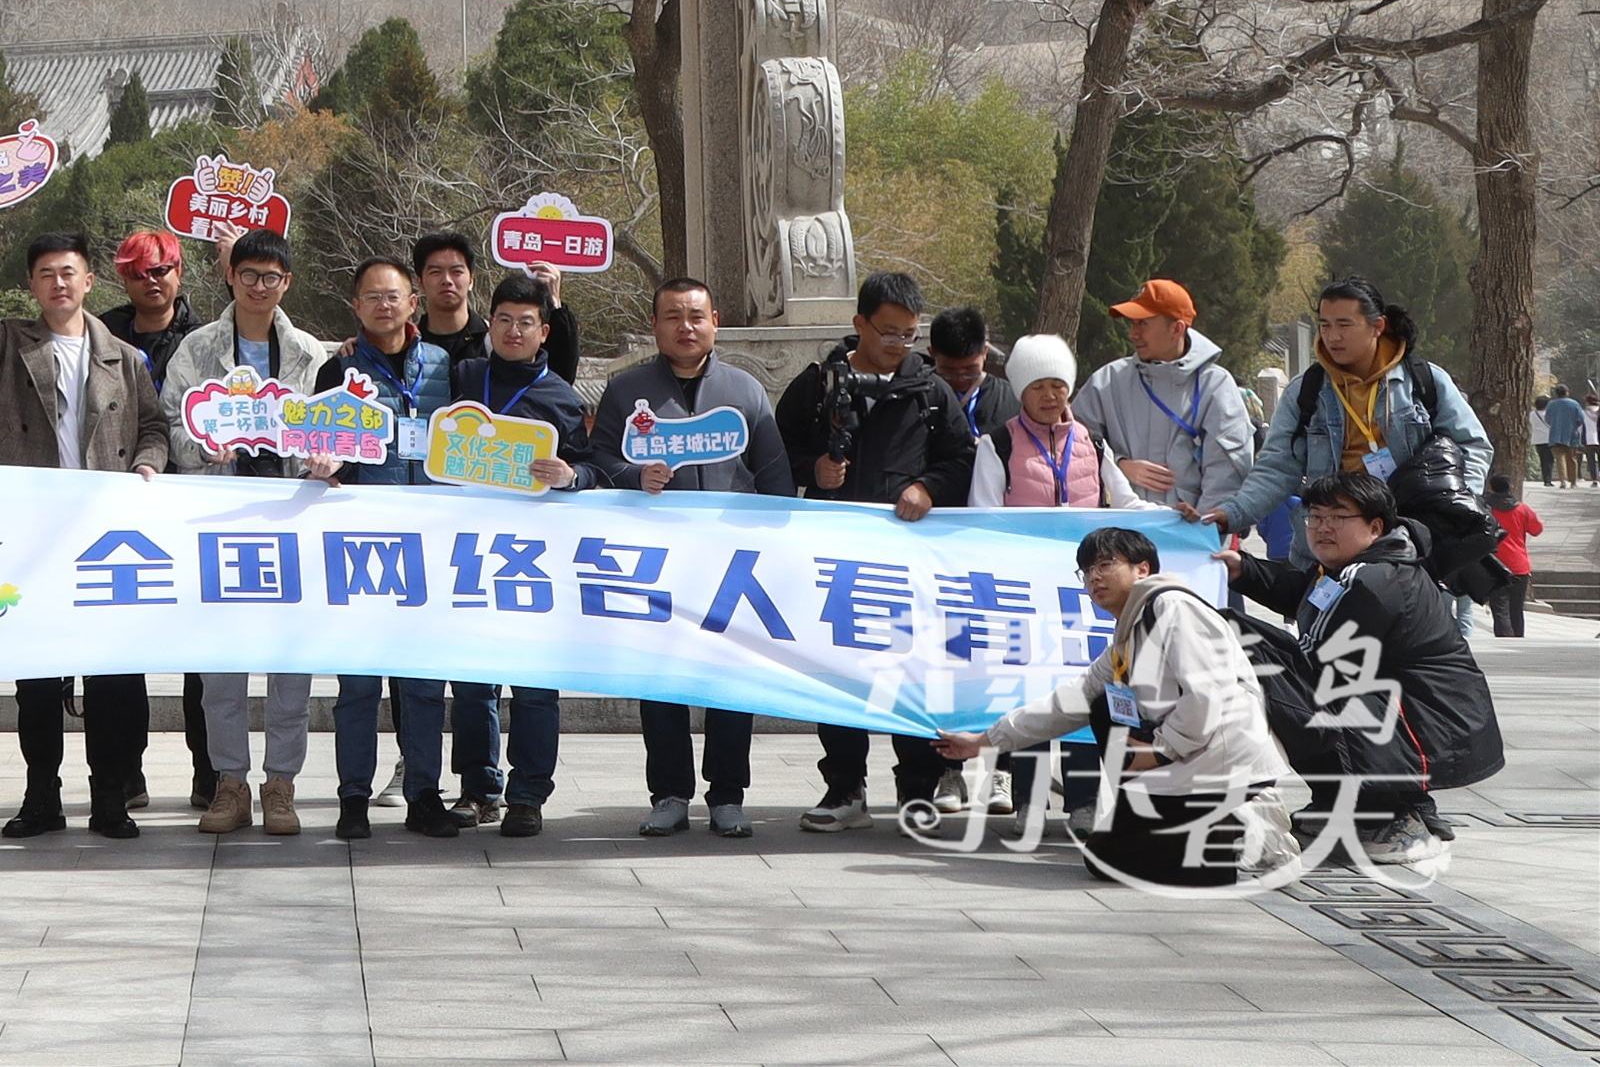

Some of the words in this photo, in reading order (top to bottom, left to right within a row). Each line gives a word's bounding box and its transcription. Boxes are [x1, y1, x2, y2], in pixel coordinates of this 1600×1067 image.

[189, 192, 269, 227] 美丽乡村
[502, 230, 604, 257] 青岛一日游
[217, 400, 268, 418] 春天的
[283, 399, 385, 430] 魅力之都
[282, 429, 383, 460] 网红青岛
[445, 433, 536, 465] 文化之都
[631, 431, 741, 458] 青岛老城记忆
[443, 455, 535, 489] 魅力青岛
